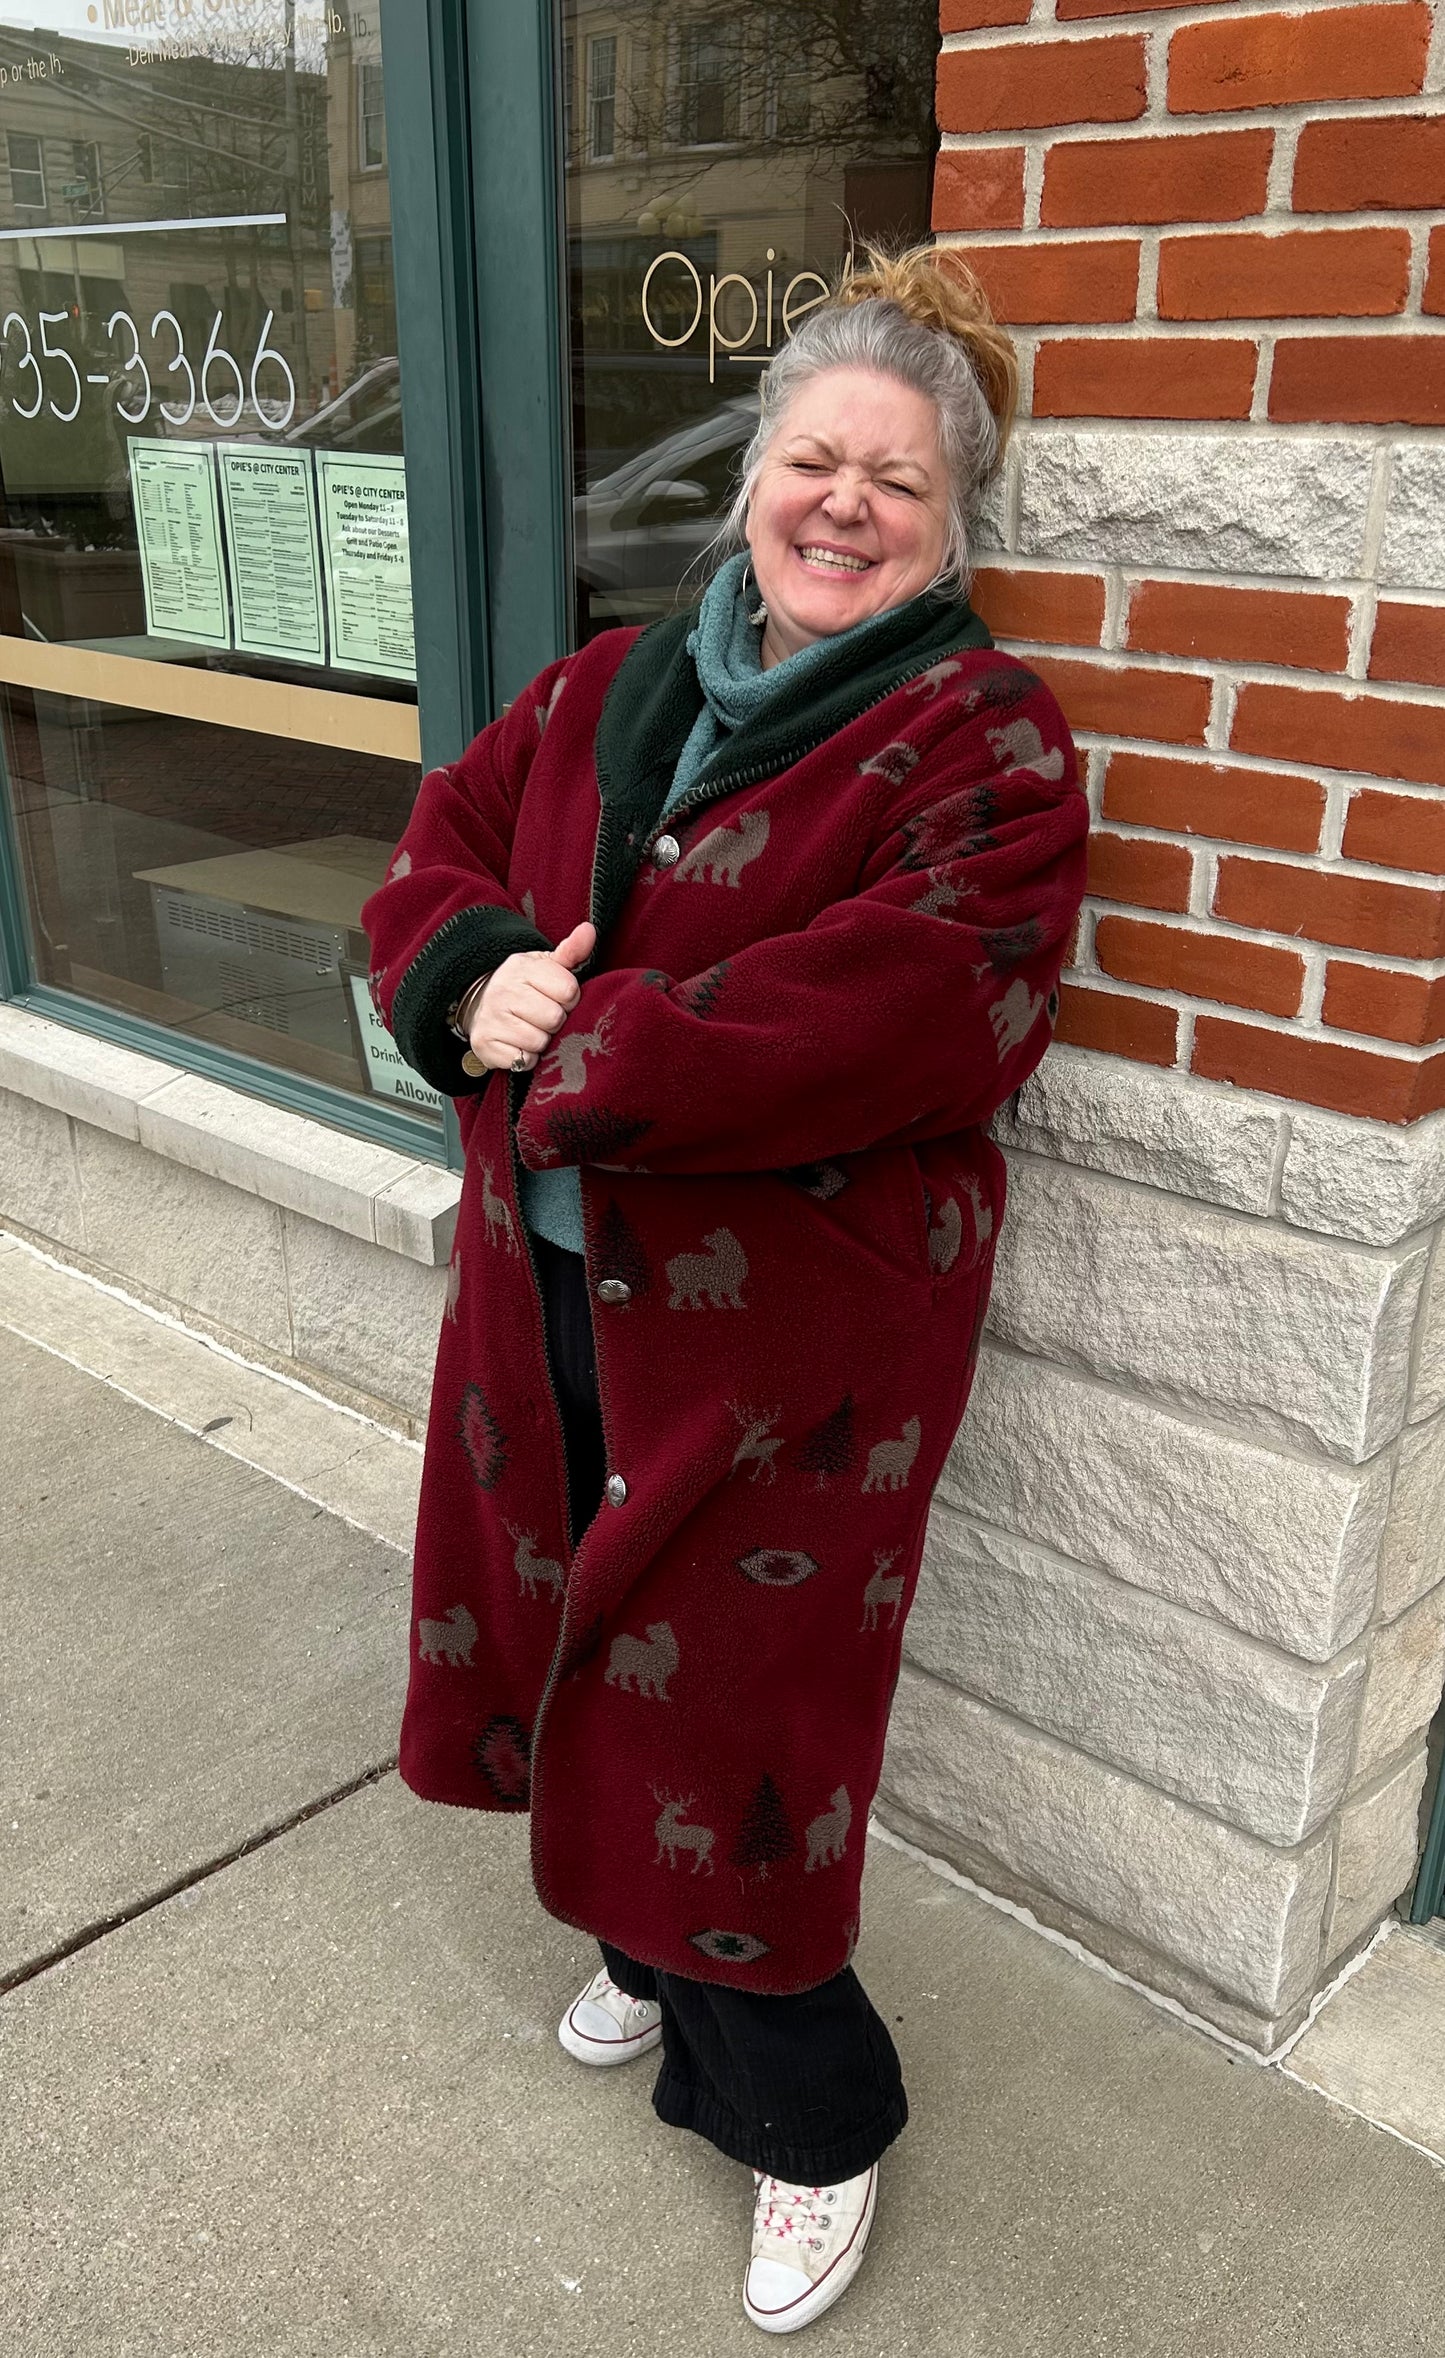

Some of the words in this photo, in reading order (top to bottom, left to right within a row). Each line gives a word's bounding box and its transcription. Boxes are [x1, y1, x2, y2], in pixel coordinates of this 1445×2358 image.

[327, 8, 346, 34] lb.
[11, 64, 23, 82] or
[27, 56, 47, 80] the
[0, 310, 295, 430] 35-3366
[231, 461, 252, 472] OPIE'S
[253, 463, 260, 475] @
[260, 463, 275, 474] CITY
[275, 464, 300, 476] CENTER
[332, 484, 354, 496] OPIE'S
[355, 486, 362, 498] @
[363, 487, 378, 498] CITY
[379, 488, 405, 500] CENTER
[344, 500, 357, 510] Open
[358, 501, 379, 513] Monday
[336, 511, 358, 522] Tuesday
[365, 514, 388, 526] Saturday
[342, 524, 351, 532] Ask
[352, 525, 368, 535] about
[377, 527, 400, 538] Desserts
[358, 538, 368, 546] and
[369, 539, 382, 548] Patio
[383, 541, 397, 551] Open
[342, 547, 365, 560] Thursday
[366, 552, 376, 560] and
[377, 552, 393, 564] Friday
